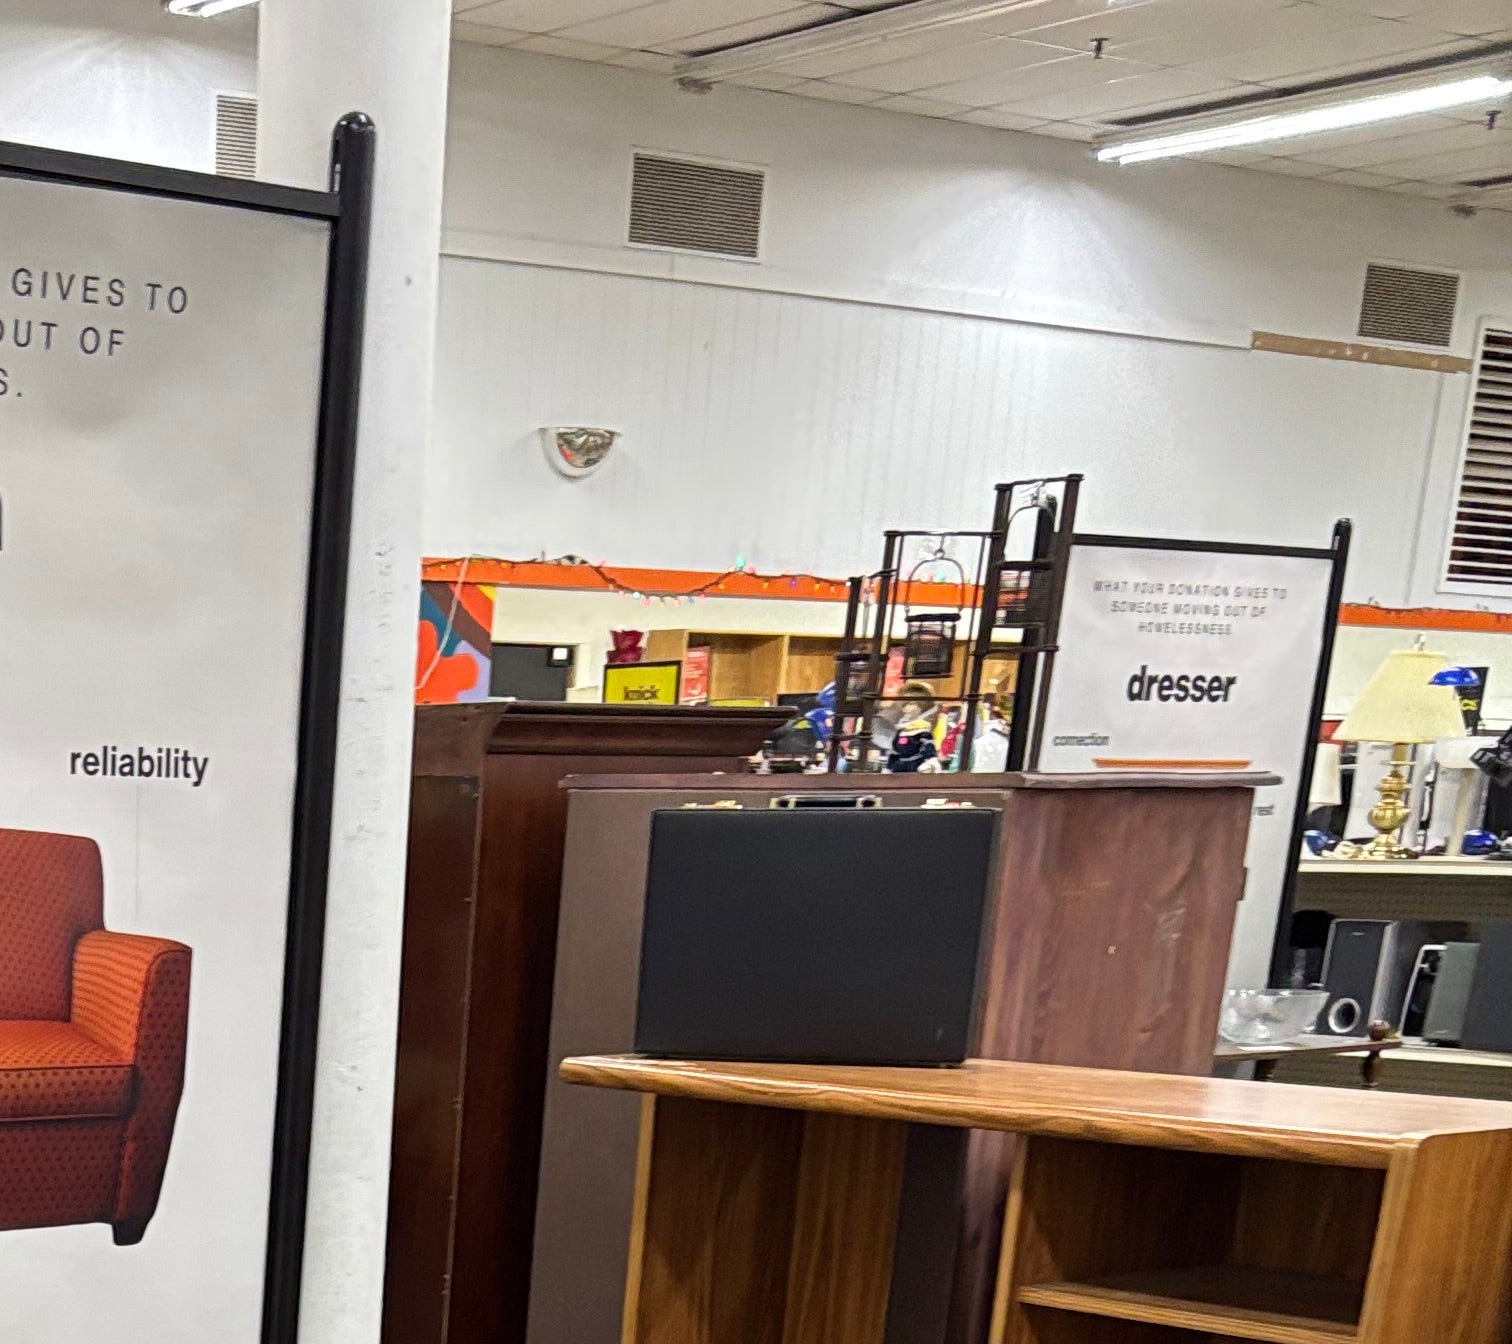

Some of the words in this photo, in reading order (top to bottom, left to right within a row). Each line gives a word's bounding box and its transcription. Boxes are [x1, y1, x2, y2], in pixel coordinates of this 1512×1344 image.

[11, 268, 126, 307] GIVES
[144, 282, 188, 314] TO
[80, 326, 125, 356] OF
[1134, 582, 1164, 595] YOUR
[1168, 583, 1230, 597] DONATION
[1110, 600, 1169, 615] SOMEONE
[1173, 603, 1220, 617] MOVING
[1224, 604, 1248, 617] OUT
[1127, 664, 1237, 702] dresser
[69, 745, 210, 788] reliability
